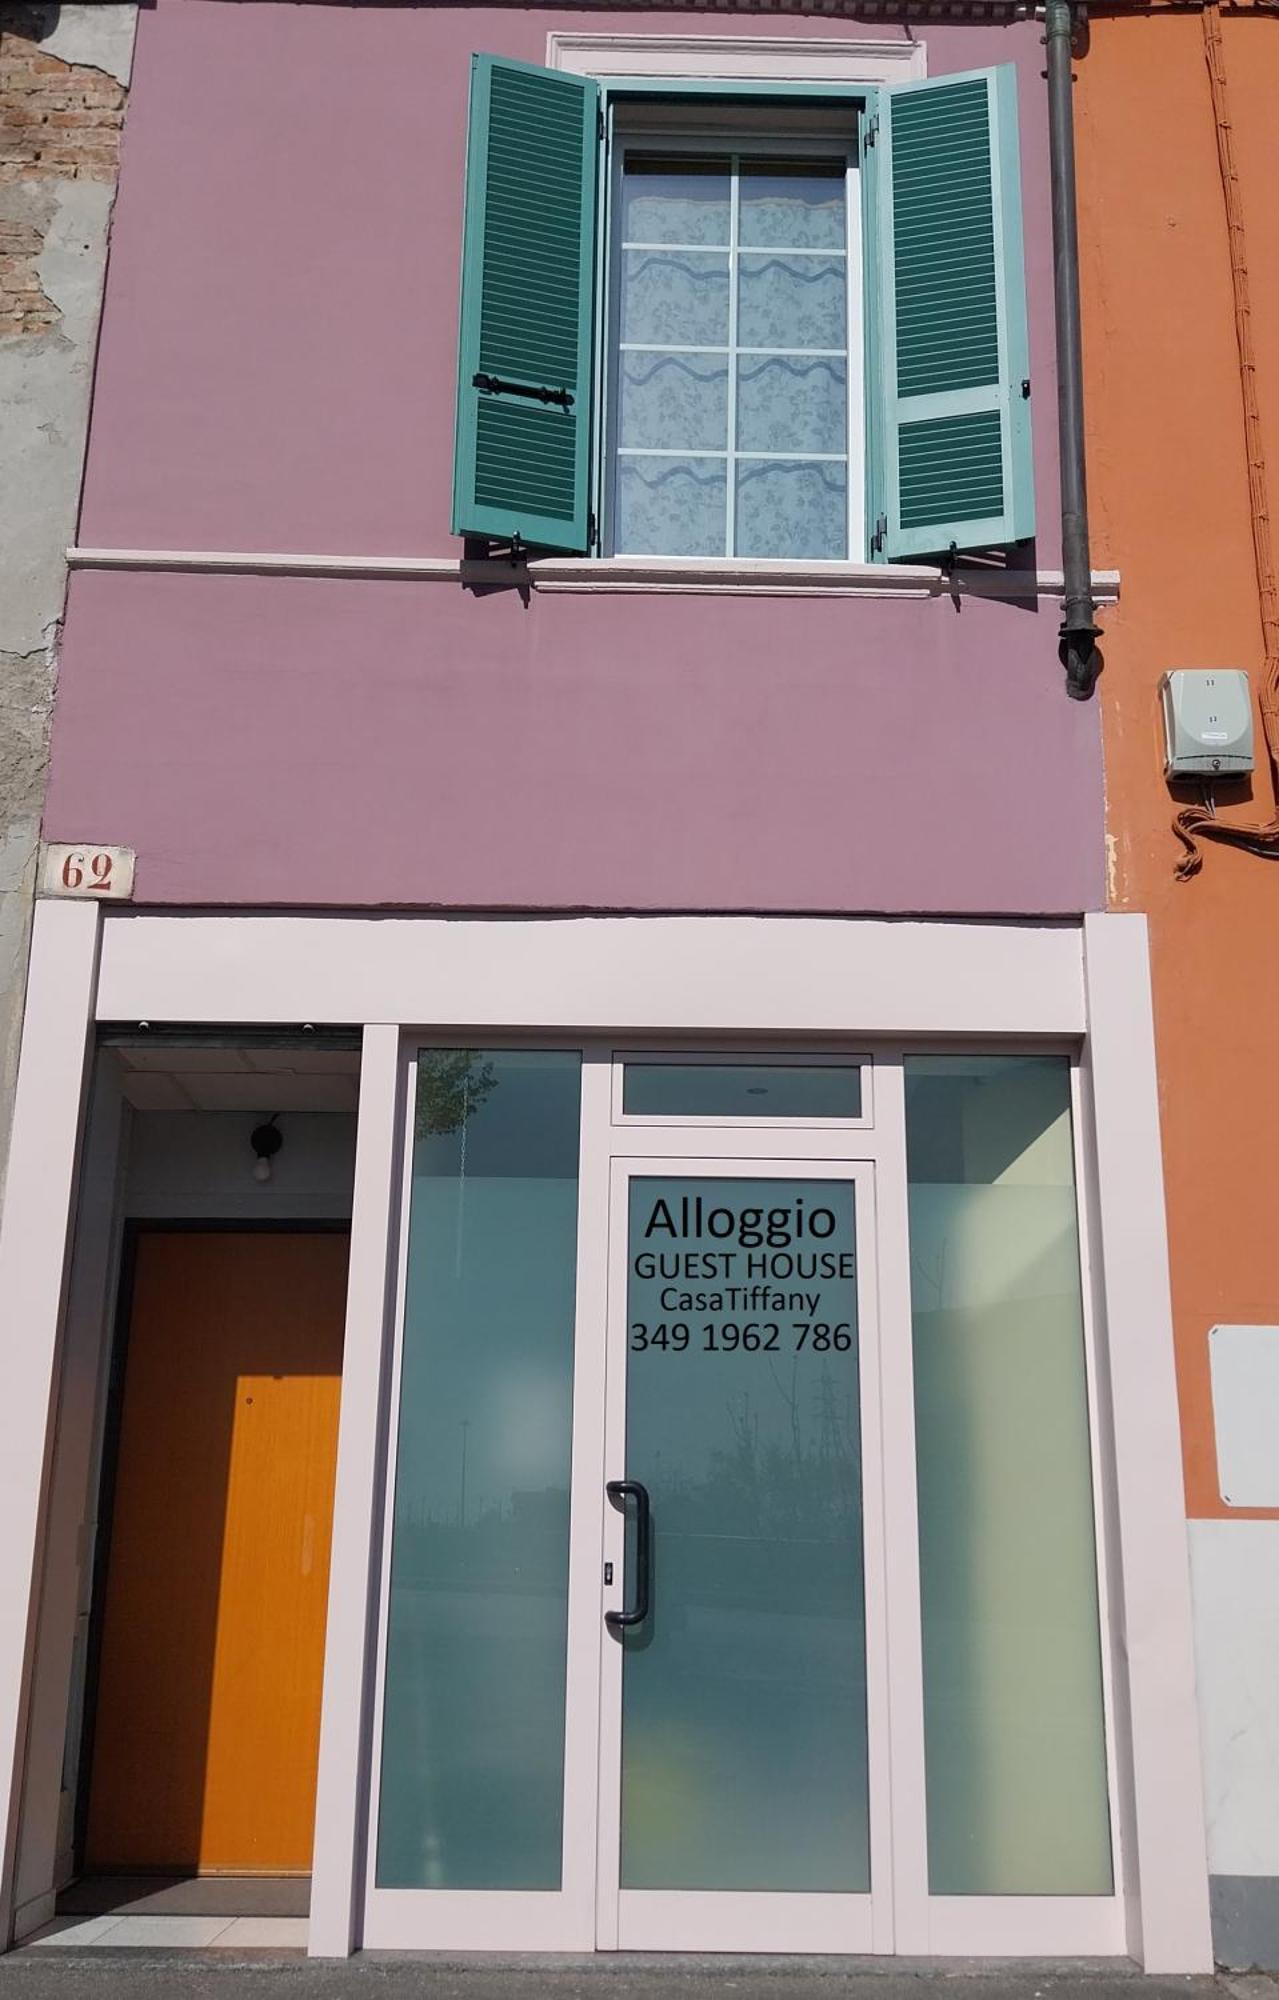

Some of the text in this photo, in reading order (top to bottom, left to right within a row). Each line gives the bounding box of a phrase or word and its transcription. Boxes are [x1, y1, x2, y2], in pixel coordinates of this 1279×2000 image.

[62, 852, 113, 890] 62
[644, 1197, 836, 1248] Alloggio
[634, 1253, 855, 1279] GUEST HOUSE
[660, 1286, 821, 1317] CasaTiffany
[631, 1323, 852, 1351] 349 1962 786
